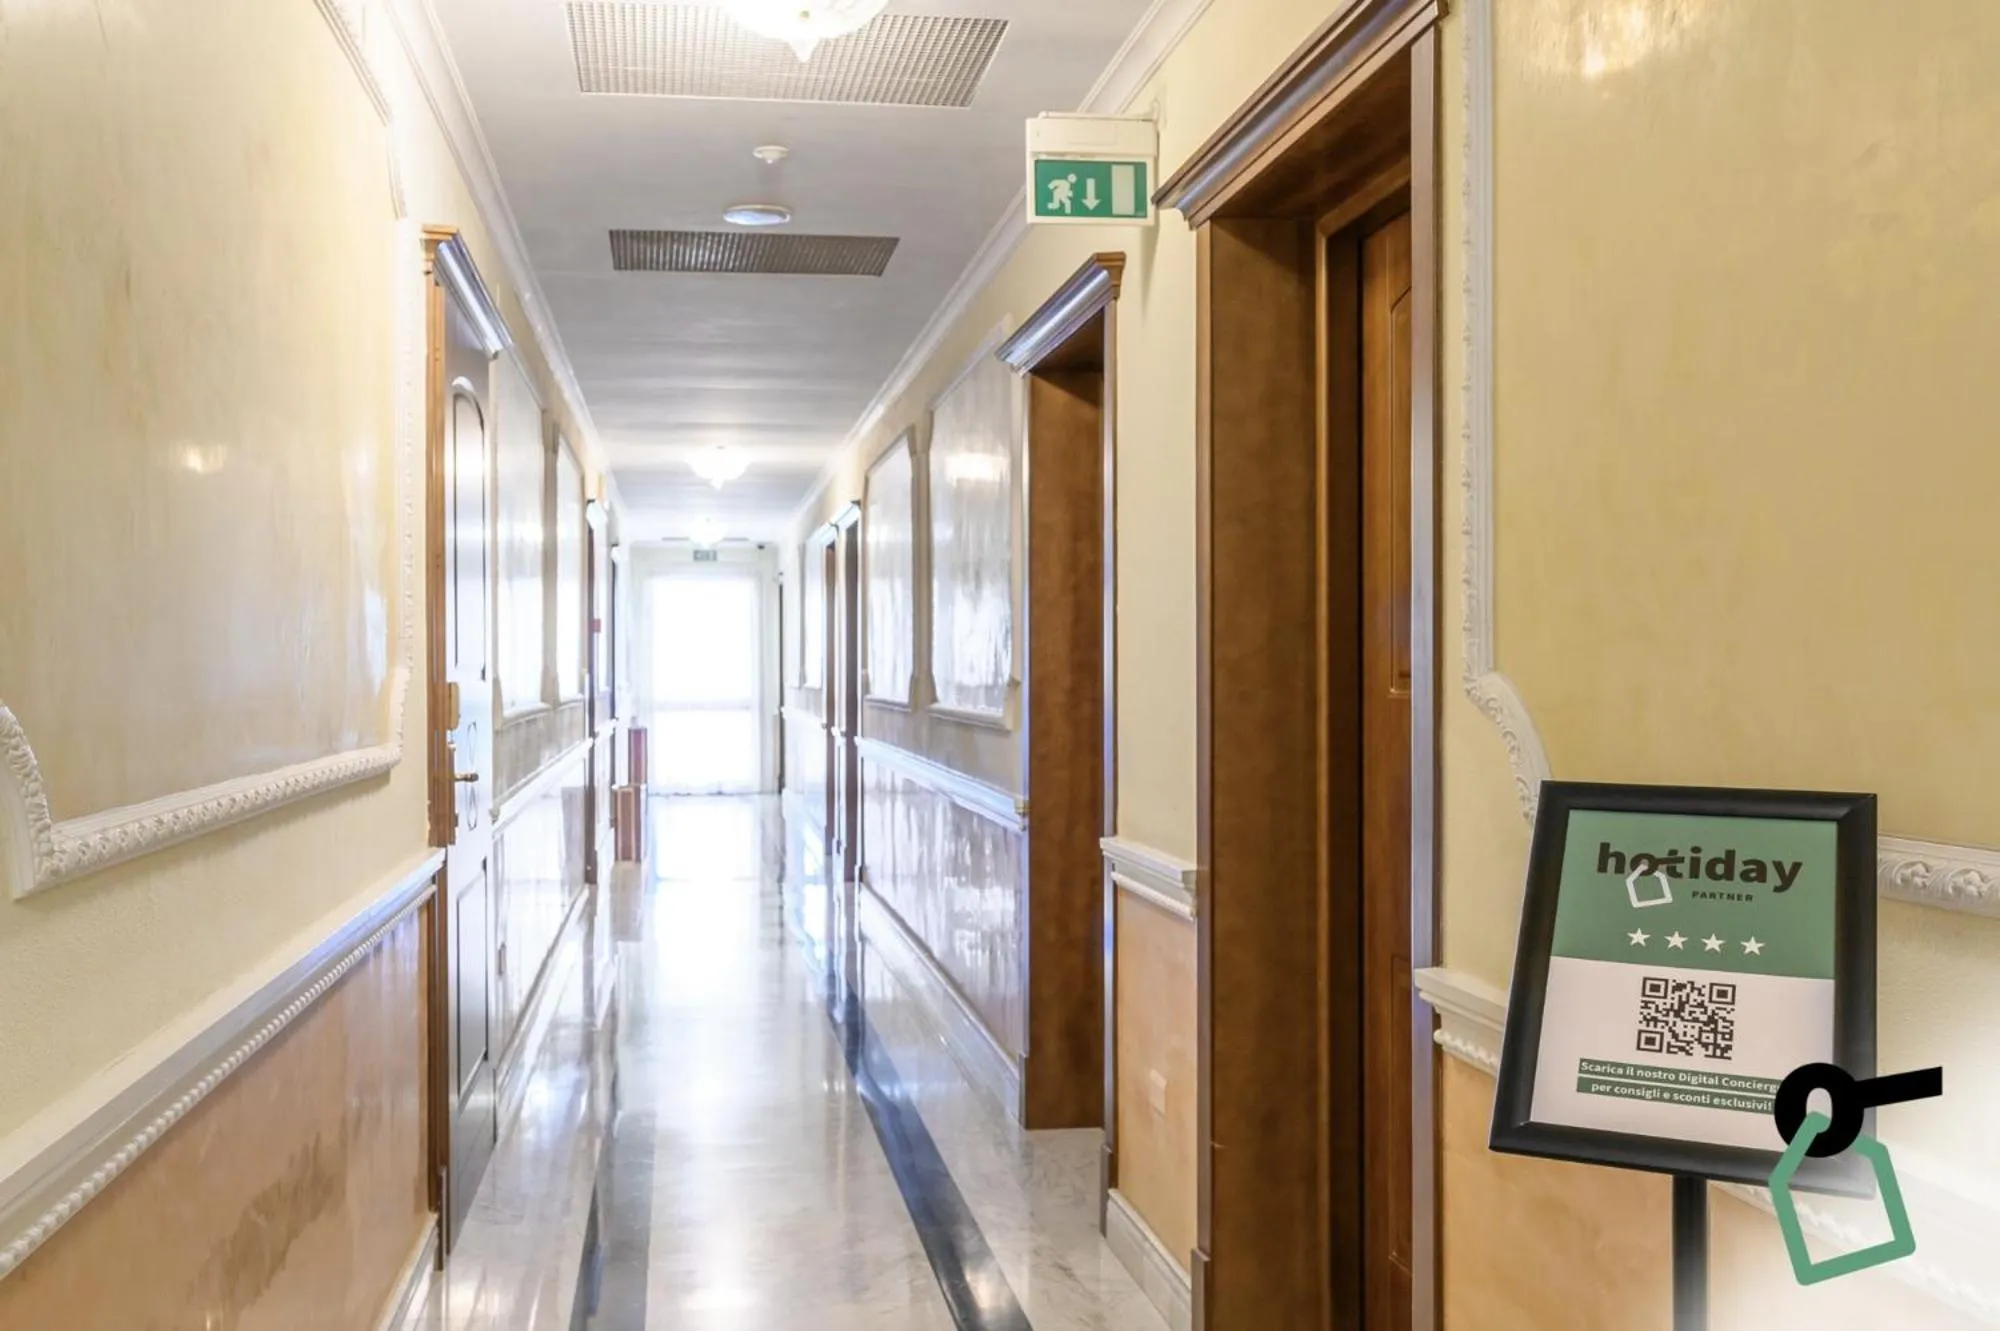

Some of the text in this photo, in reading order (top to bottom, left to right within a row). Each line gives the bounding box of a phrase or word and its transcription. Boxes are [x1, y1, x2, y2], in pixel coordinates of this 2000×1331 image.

[1597, 842, 1803, 893] hotiday
[1691, 891, 1754, 902] PARTNER
[1580, 1061, 1623, 1075] Scarica
[1626, 1066, 1634, 1076] il
[1636, 1069, 1675, 1081] nostro
[1679, 1072, 1719, 1085] Digital
[1591, 1083, 1773, 1111] per consigli e sconti esclusivi!
